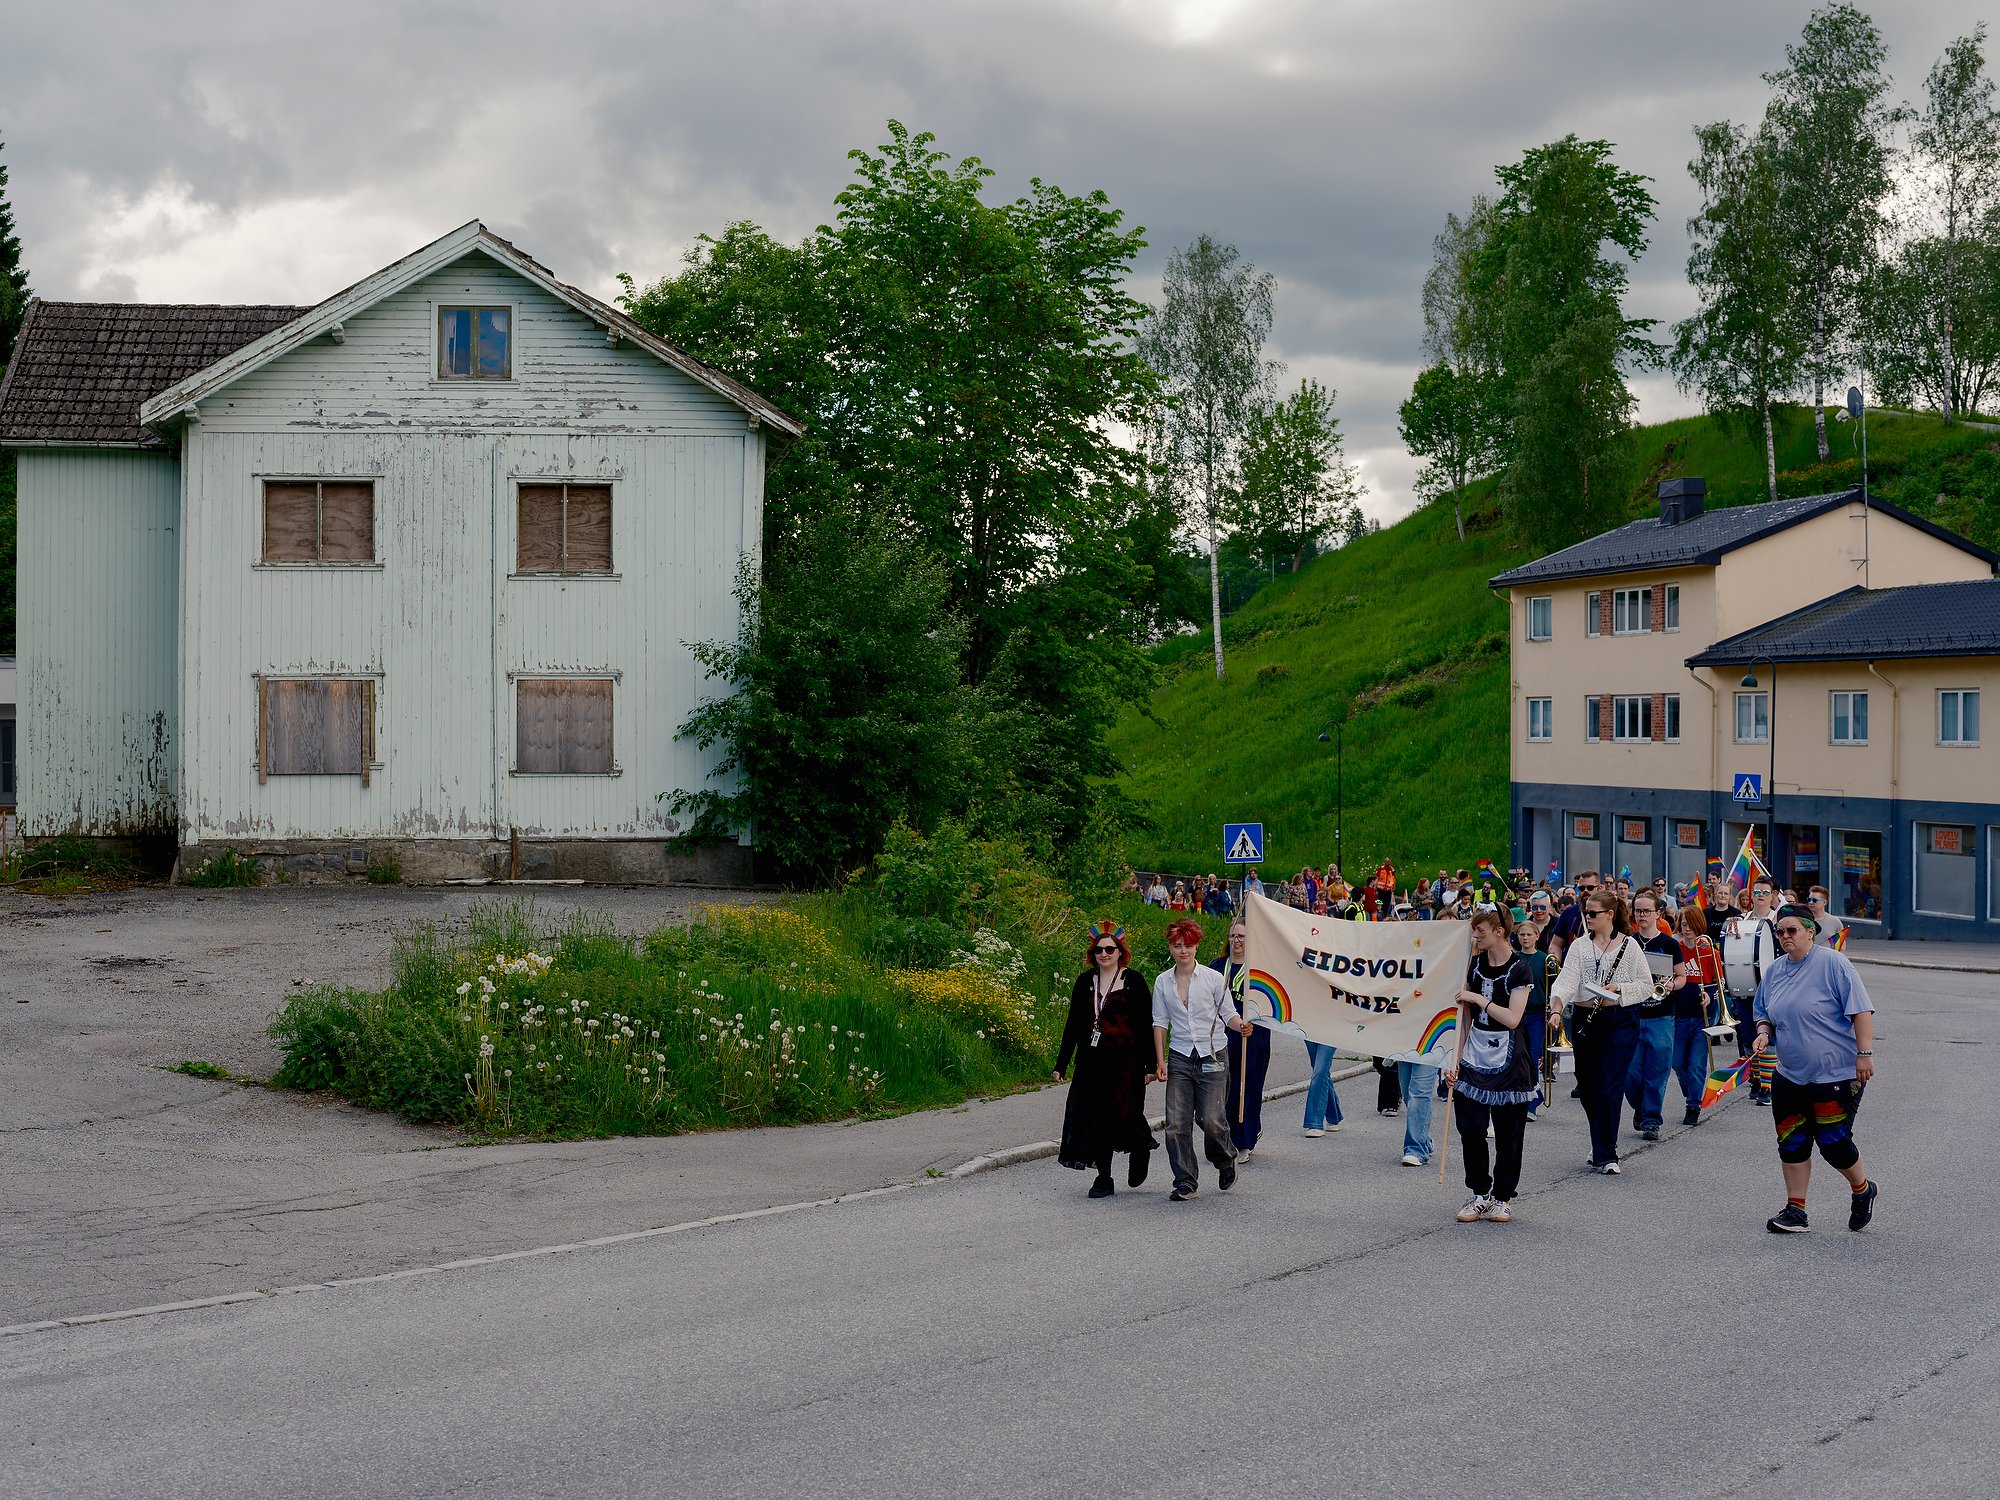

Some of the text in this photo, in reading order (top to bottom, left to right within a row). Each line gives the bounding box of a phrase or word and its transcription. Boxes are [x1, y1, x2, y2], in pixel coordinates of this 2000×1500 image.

[1935, 829, 1959, 840] LOVELY
[1935, 839, 1959, 850] PLANET
[1302, 946, 1424, 979] EIDSVOLL
[1685, 969, 1704, 977] didas
[1329, 984, 1401, 1014] PRIDE
